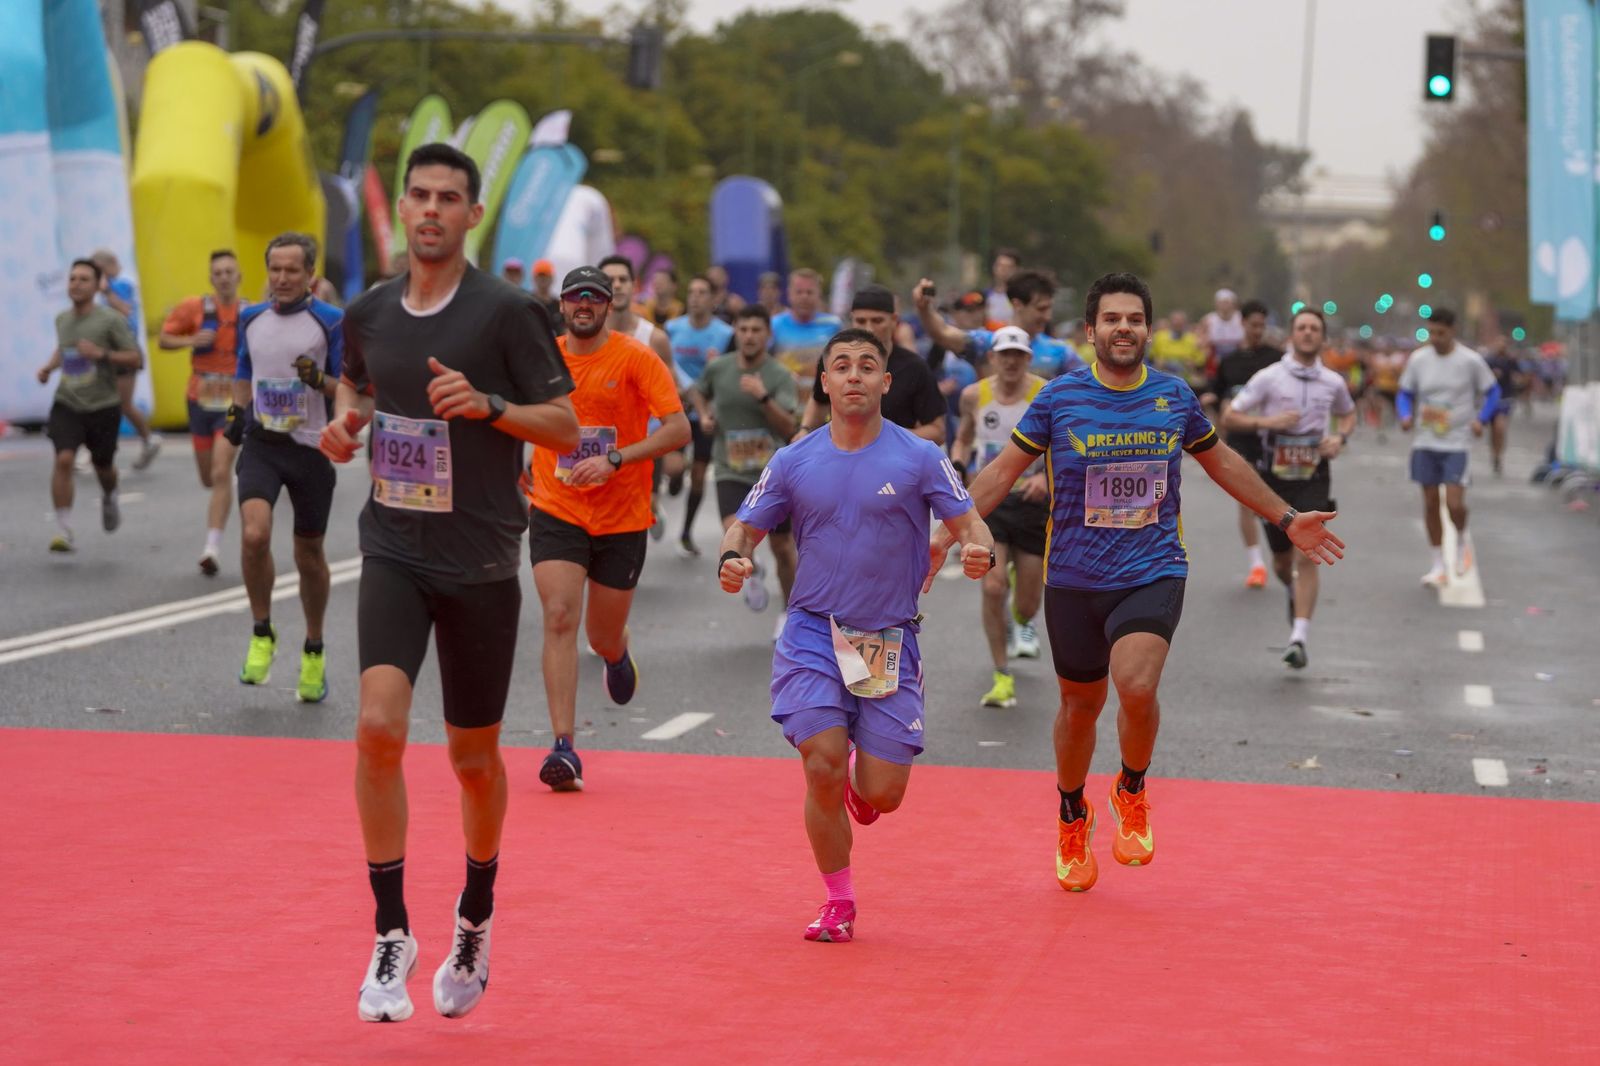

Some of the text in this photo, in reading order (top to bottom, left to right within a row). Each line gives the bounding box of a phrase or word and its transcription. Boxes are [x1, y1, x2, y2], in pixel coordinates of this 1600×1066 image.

[1087, 431, 1168, 448] BREAKING 3
[380, 438, 427, 469] 1924
[1088, 450, 1110, 458] YOU'LL
[1111, 449, 1133, 457] NEVER
[1099, 477, 1148, 498] 1890
[849, 641, 881, 665] 17
